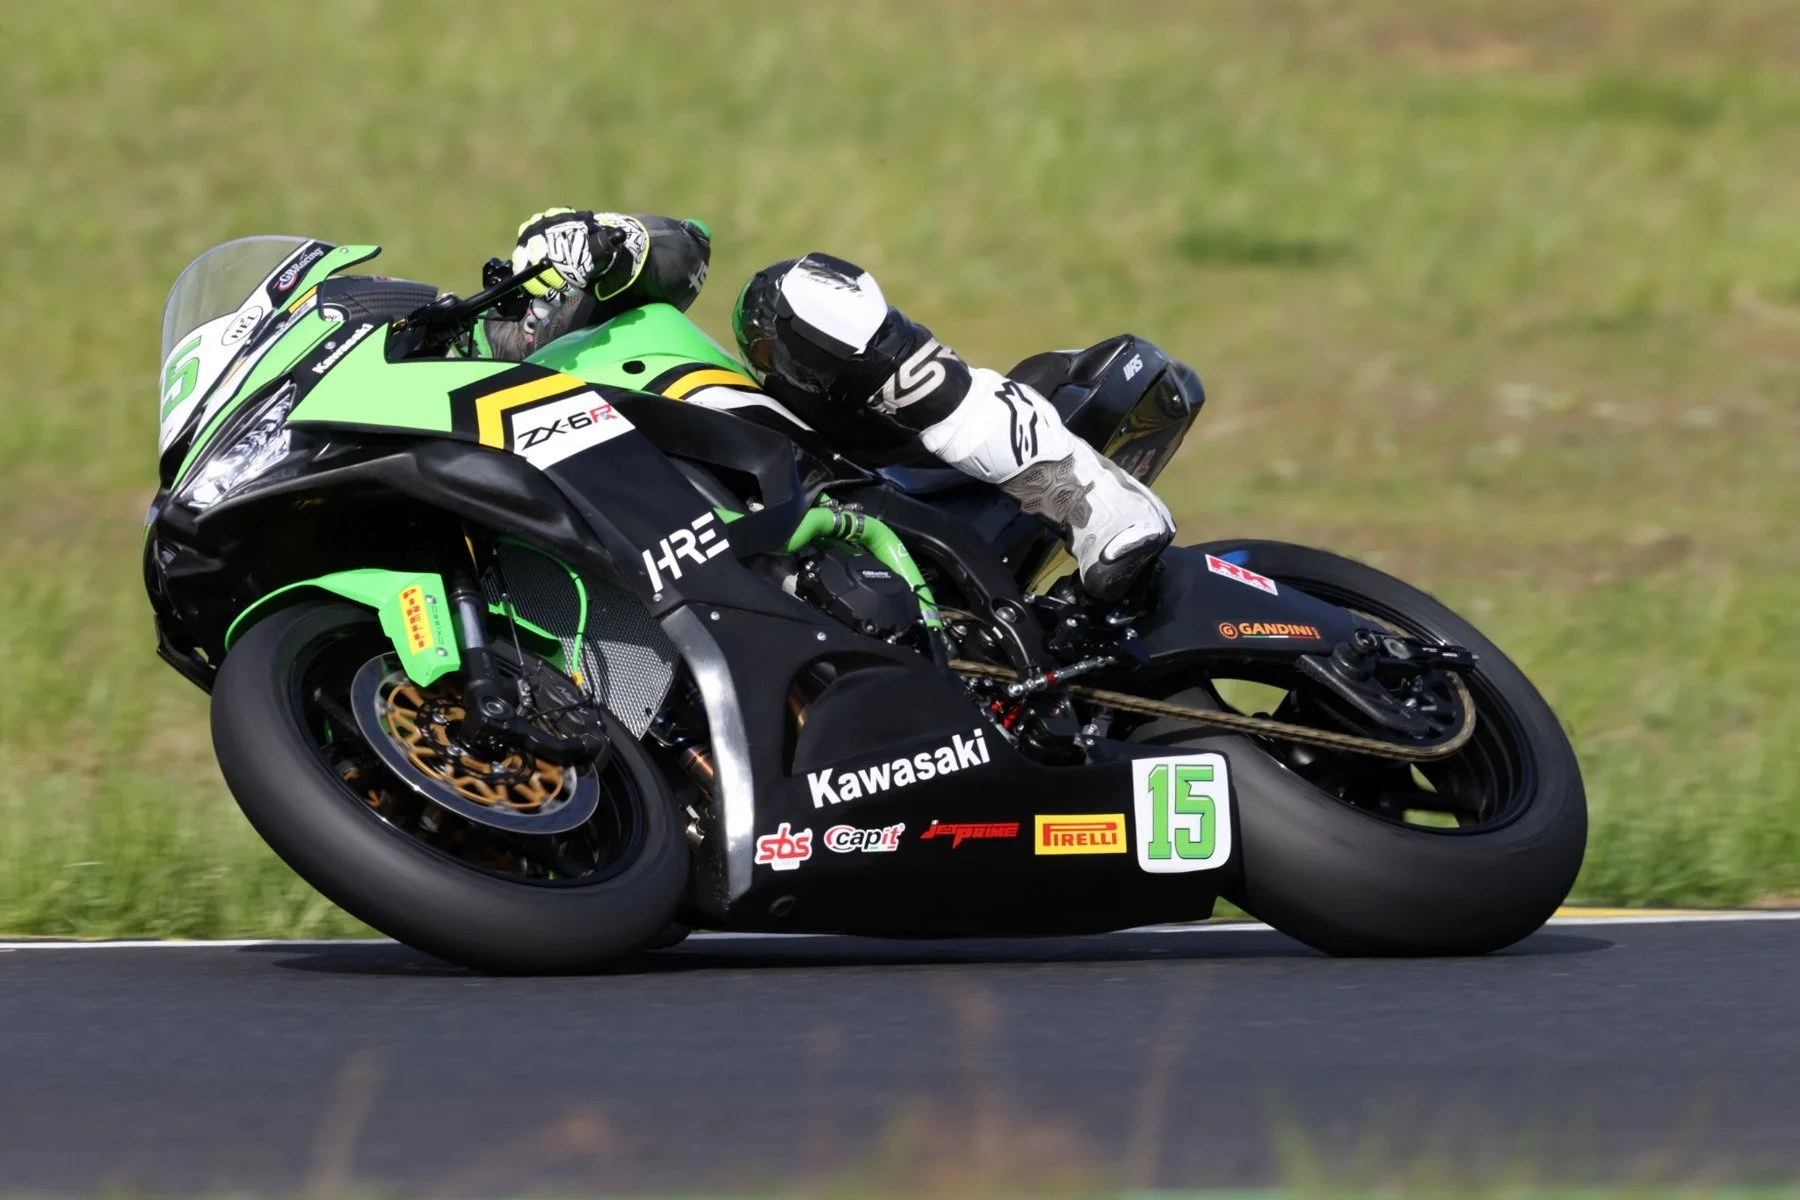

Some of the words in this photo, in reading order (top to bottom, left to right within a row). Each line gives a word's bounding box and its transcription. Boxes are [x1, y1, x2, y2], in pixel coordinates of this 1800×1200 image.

[279, 247, 324, 282] GBRacing
[517, 403, 618, 451] ZX-6R
[642, 511, 730, 593] HRE
[1209, 557, 1272, 589] RK
[1238, 623, 1313, 636] GANDINI
[807, 728, 990, 808] Kawasaki
[1148, 764, 1216, 859] 15
[760, 827, 809, 861] sbs
[1043, 822, 1117, 846] PIRELLI
